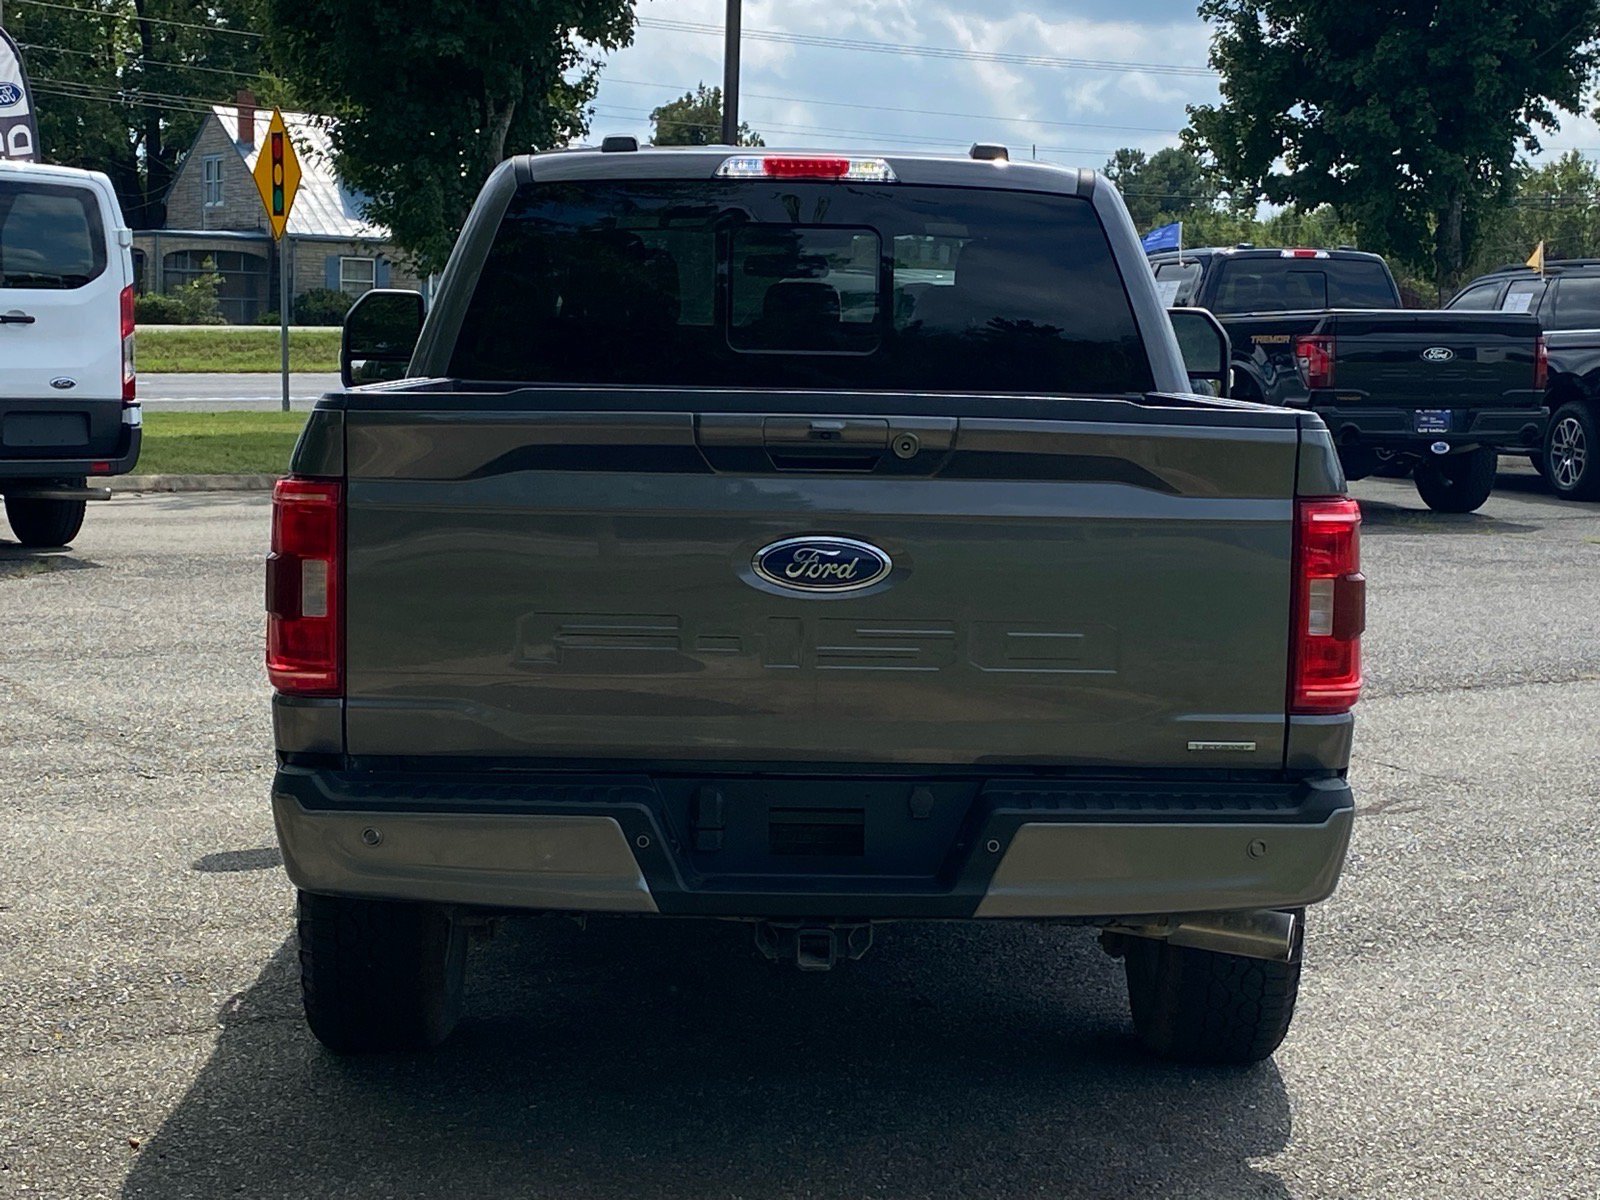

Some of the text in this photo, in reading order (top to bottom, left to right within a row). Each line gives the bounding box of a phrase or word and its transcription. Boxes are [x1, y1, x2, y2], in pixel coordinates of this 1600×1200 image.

[1251, 335, 1290, 344] TREMOR
[1428, 349, 1449, 359] Ford
[785, 547, 859, 579] Ford
